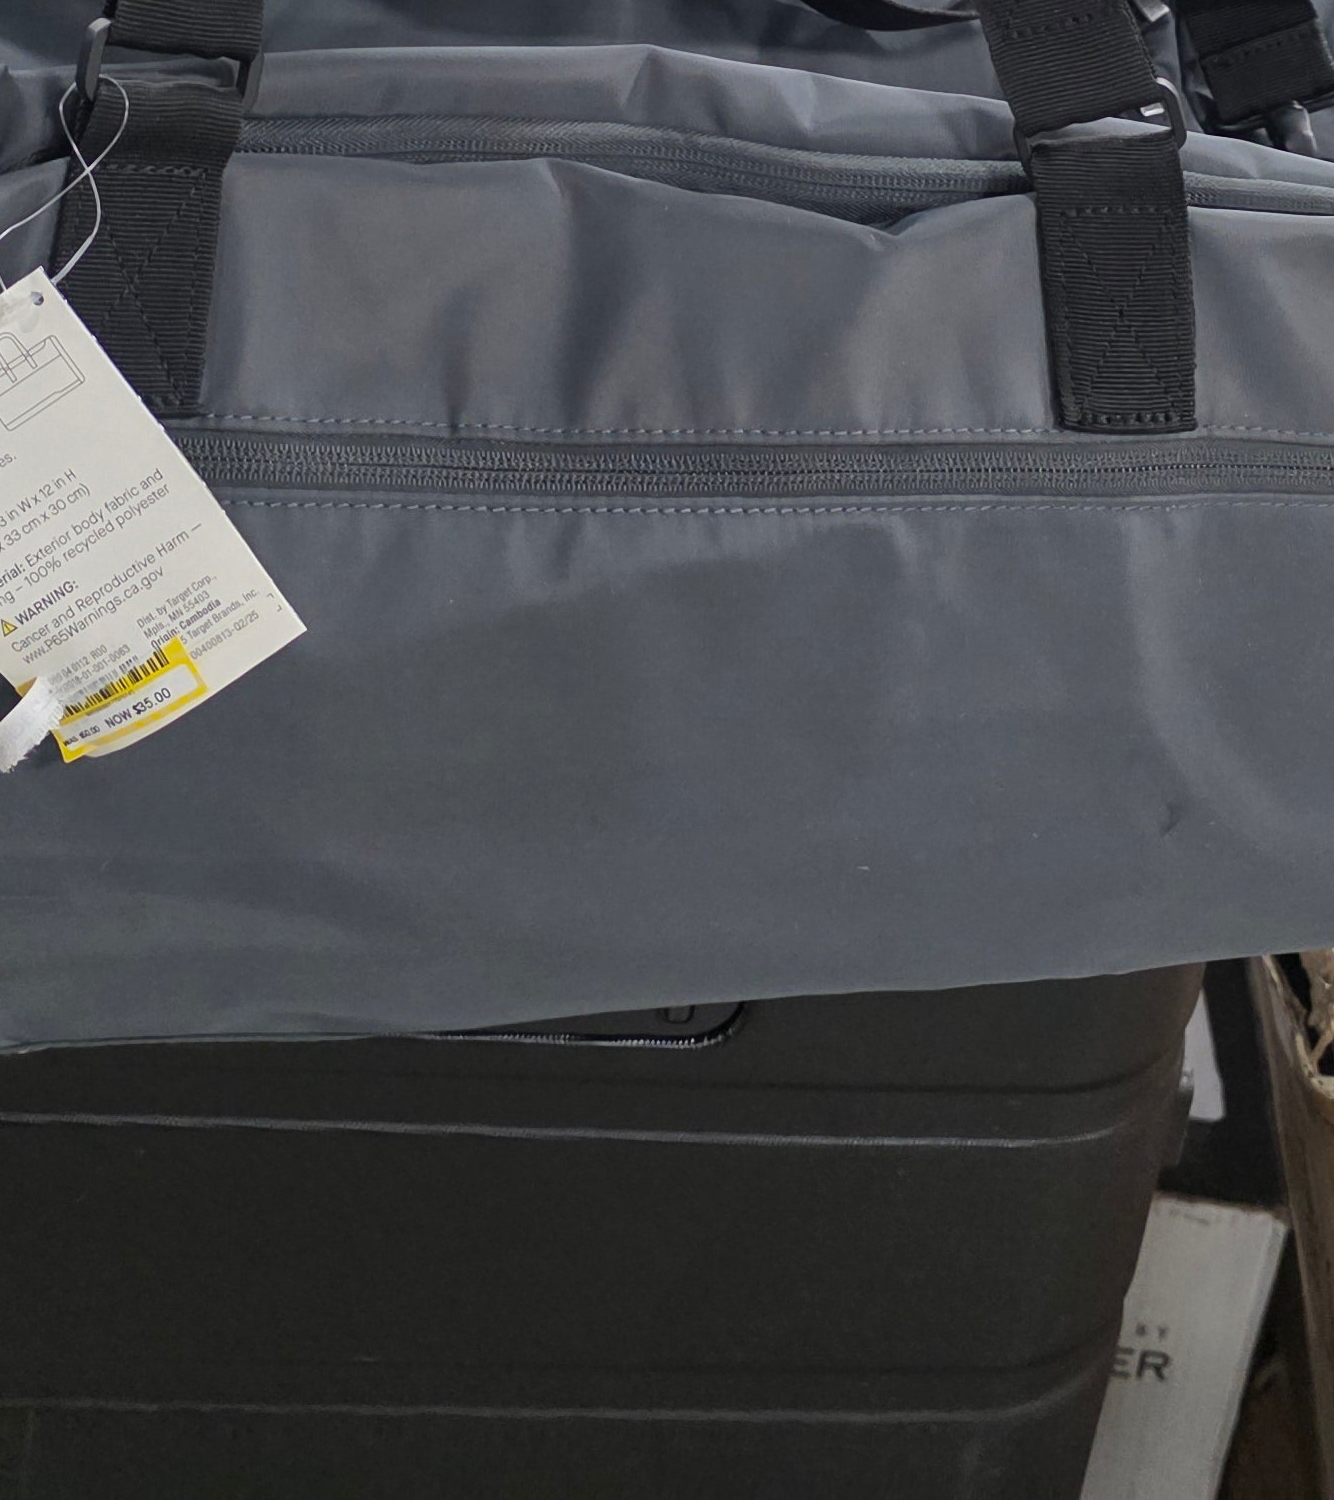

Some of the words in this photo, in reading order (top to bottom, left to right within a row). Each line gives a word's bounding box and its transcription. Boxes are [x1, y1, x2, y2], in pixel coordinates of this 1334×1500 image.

[3, 528, 21, 546] 33
[21, 517, 41, 534] cm
[39, 511, 50, 522] x
[47, 498, 66, 515] 30
[66, 482, 90, 503] cm)
[4, 509, 19, 520] in
[16, 497, 31, 512] W
[30, 494, 41, 504] x
[38, 483, 54, 498] 12
[51, 477, 66, 489] in
[63, 468, 76, 481] H
[24, 531, 71, 567] Exterior
[70, 508, 104, 535] body
[104, 486, 139, 513] fabric
[139, 467, 163, 490] and
[23, 555, 61, 586] 100%
[62, 519, 115, 561] recycled
[114, 483, 169, 529] polyester
[10, 623, 50, 652] Cancer
[51, 605, 75, 628] and
[74, 553, 155, 611] Reproductive
[155, 531, 189, 557] Harm
[14, 580, 78, 625] WARNING:
[22, 566, 163, 664] www.P65Warnings.ca.gov
[136, 612, 156, 628] Dist.
[155, 604, 167, 615] by
[165, 587, 192, 607] Target
[167, 607, 183, 621] MN
[182, 590, 209, 612] 55403
[178, 599, 221, 630] Cambodia
[186, 618, 213, 639] Target
[211, 600, 244, 623] Brands,
[241, 589, 259, 601] Inc.
[104, 708, 132, 727] NOW
[131, 687, 171, 714] $35.00
[1113, 1346, 1173, 1382] ER
